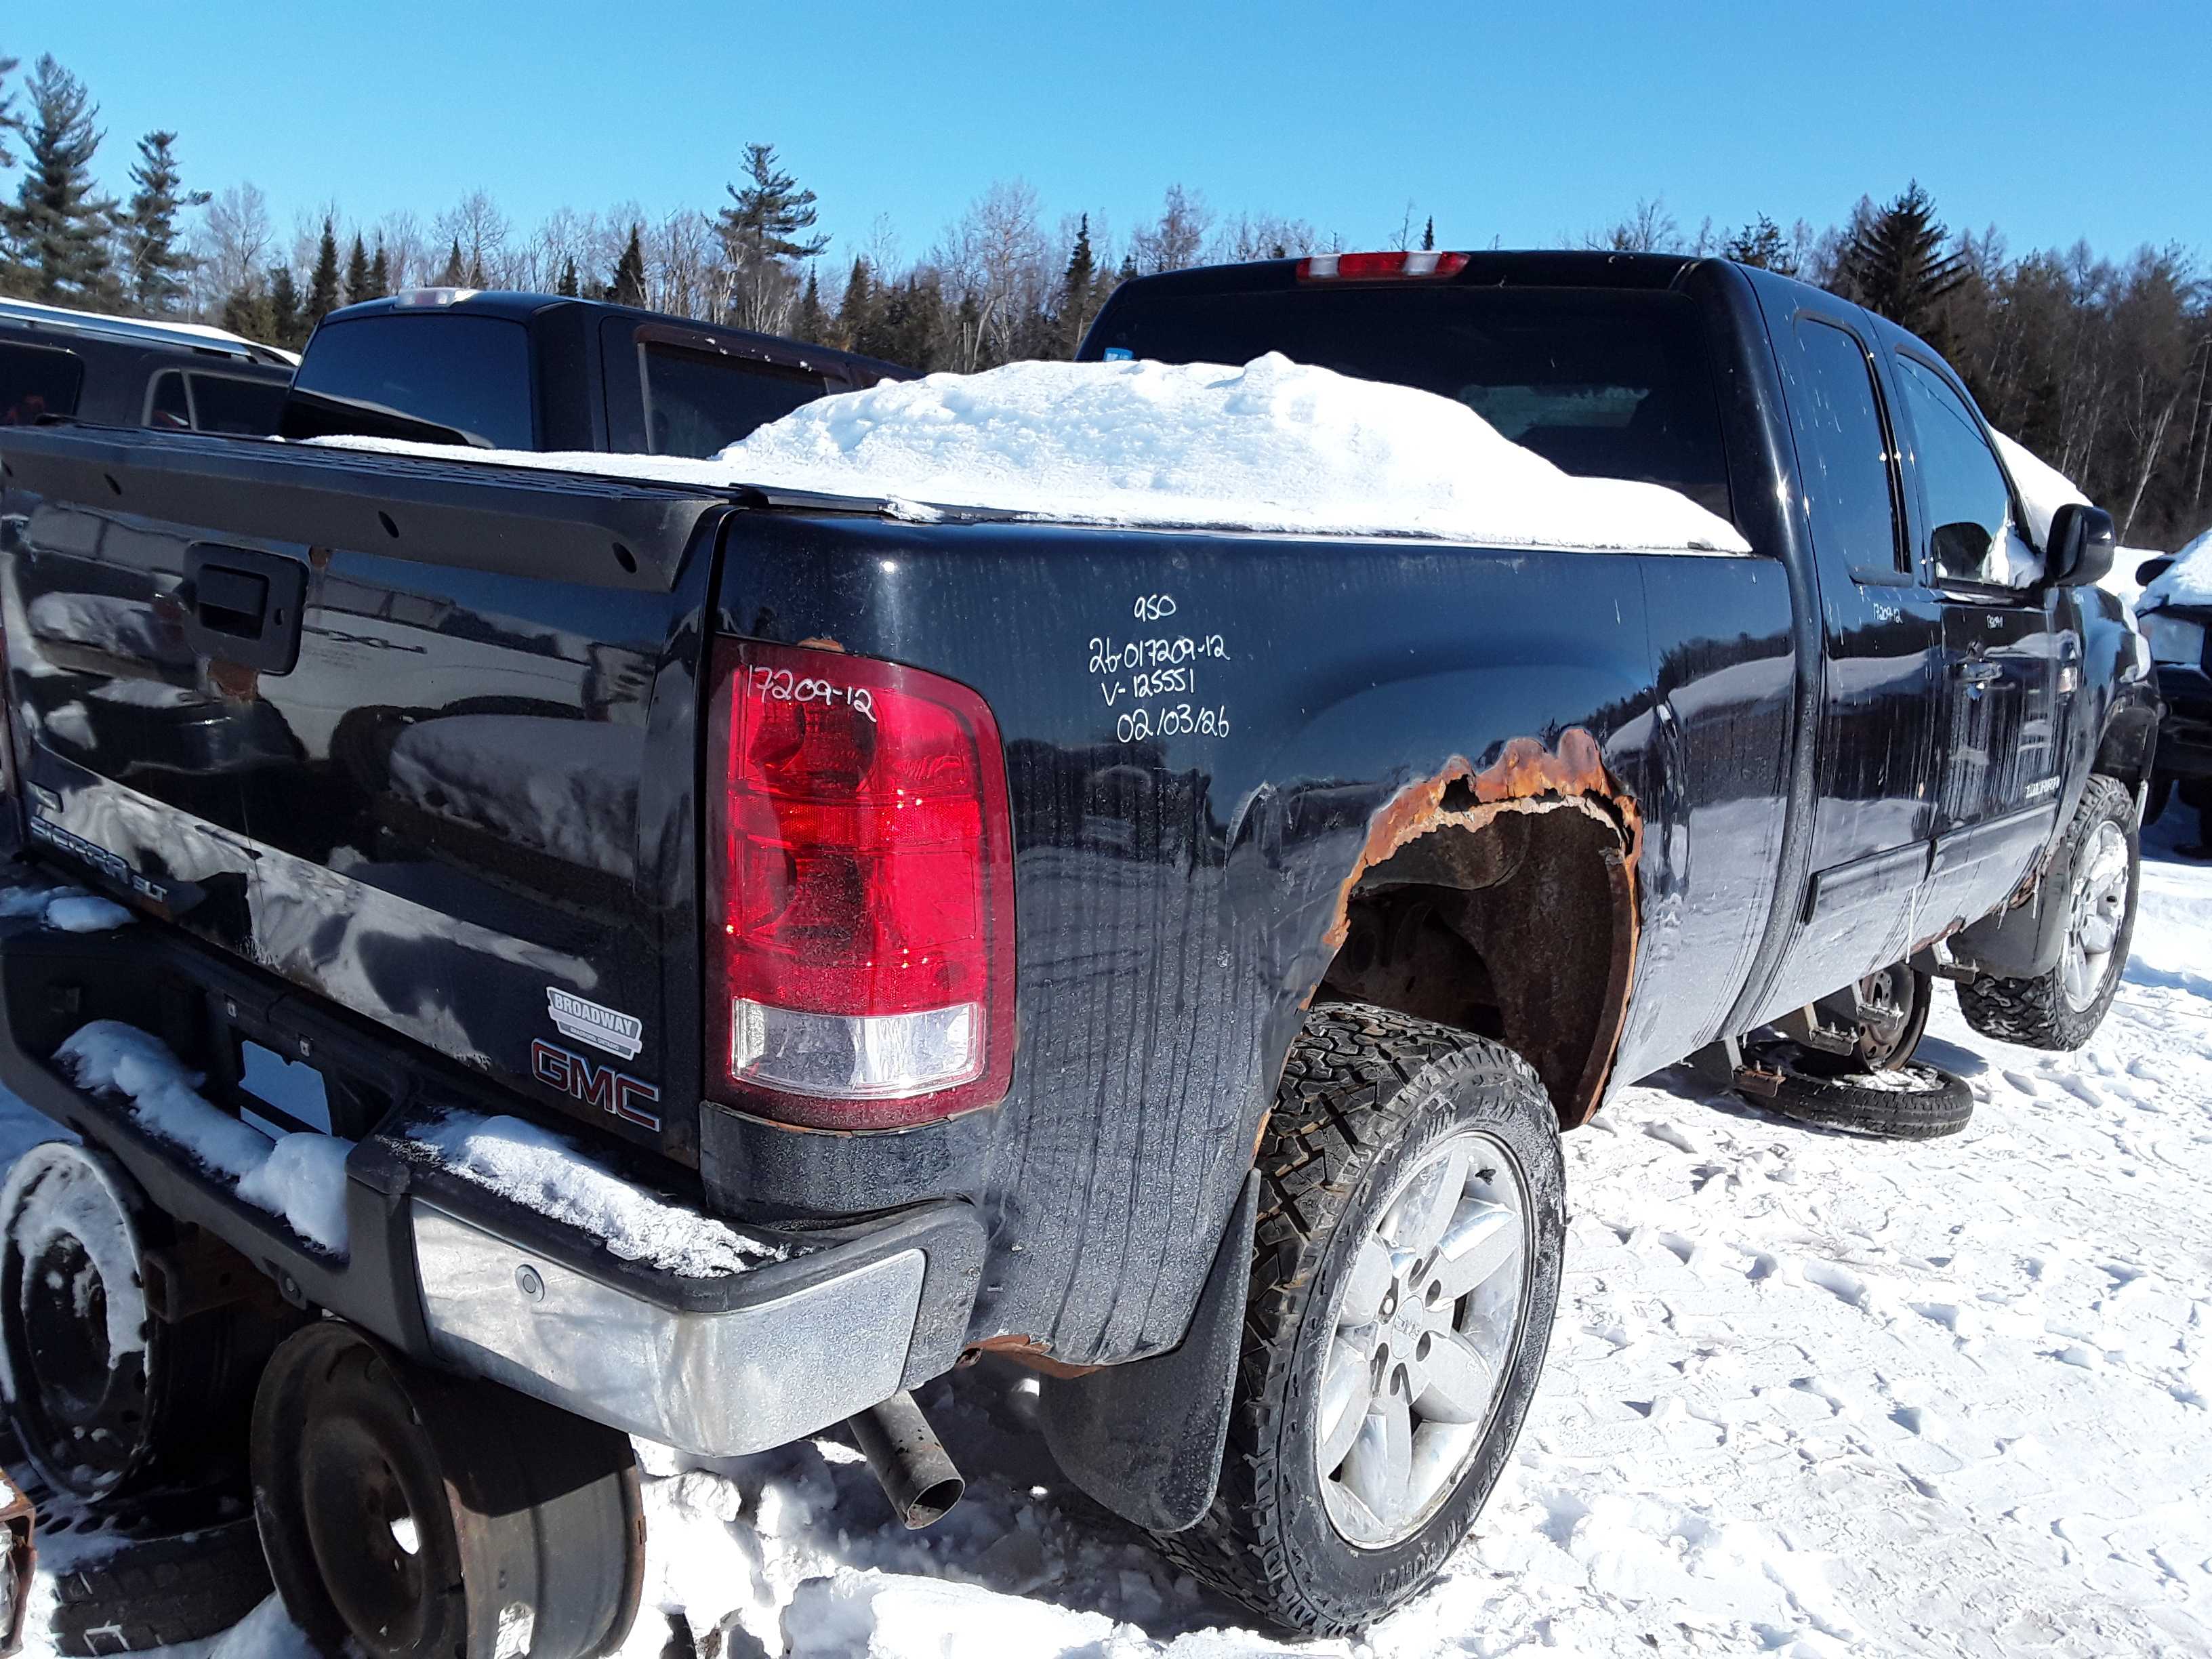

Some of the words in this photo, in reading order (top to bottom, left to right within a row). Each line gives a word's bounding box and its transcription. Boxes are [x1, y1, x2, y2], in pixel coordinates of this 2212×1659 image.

[747, 663, 878, 723] 17209-12
[1117, 703, 1230, 743] 02/03/26
[554, 993, 634, 1036] BROADWAY
[531, 1038, 661, 1133] GMC
